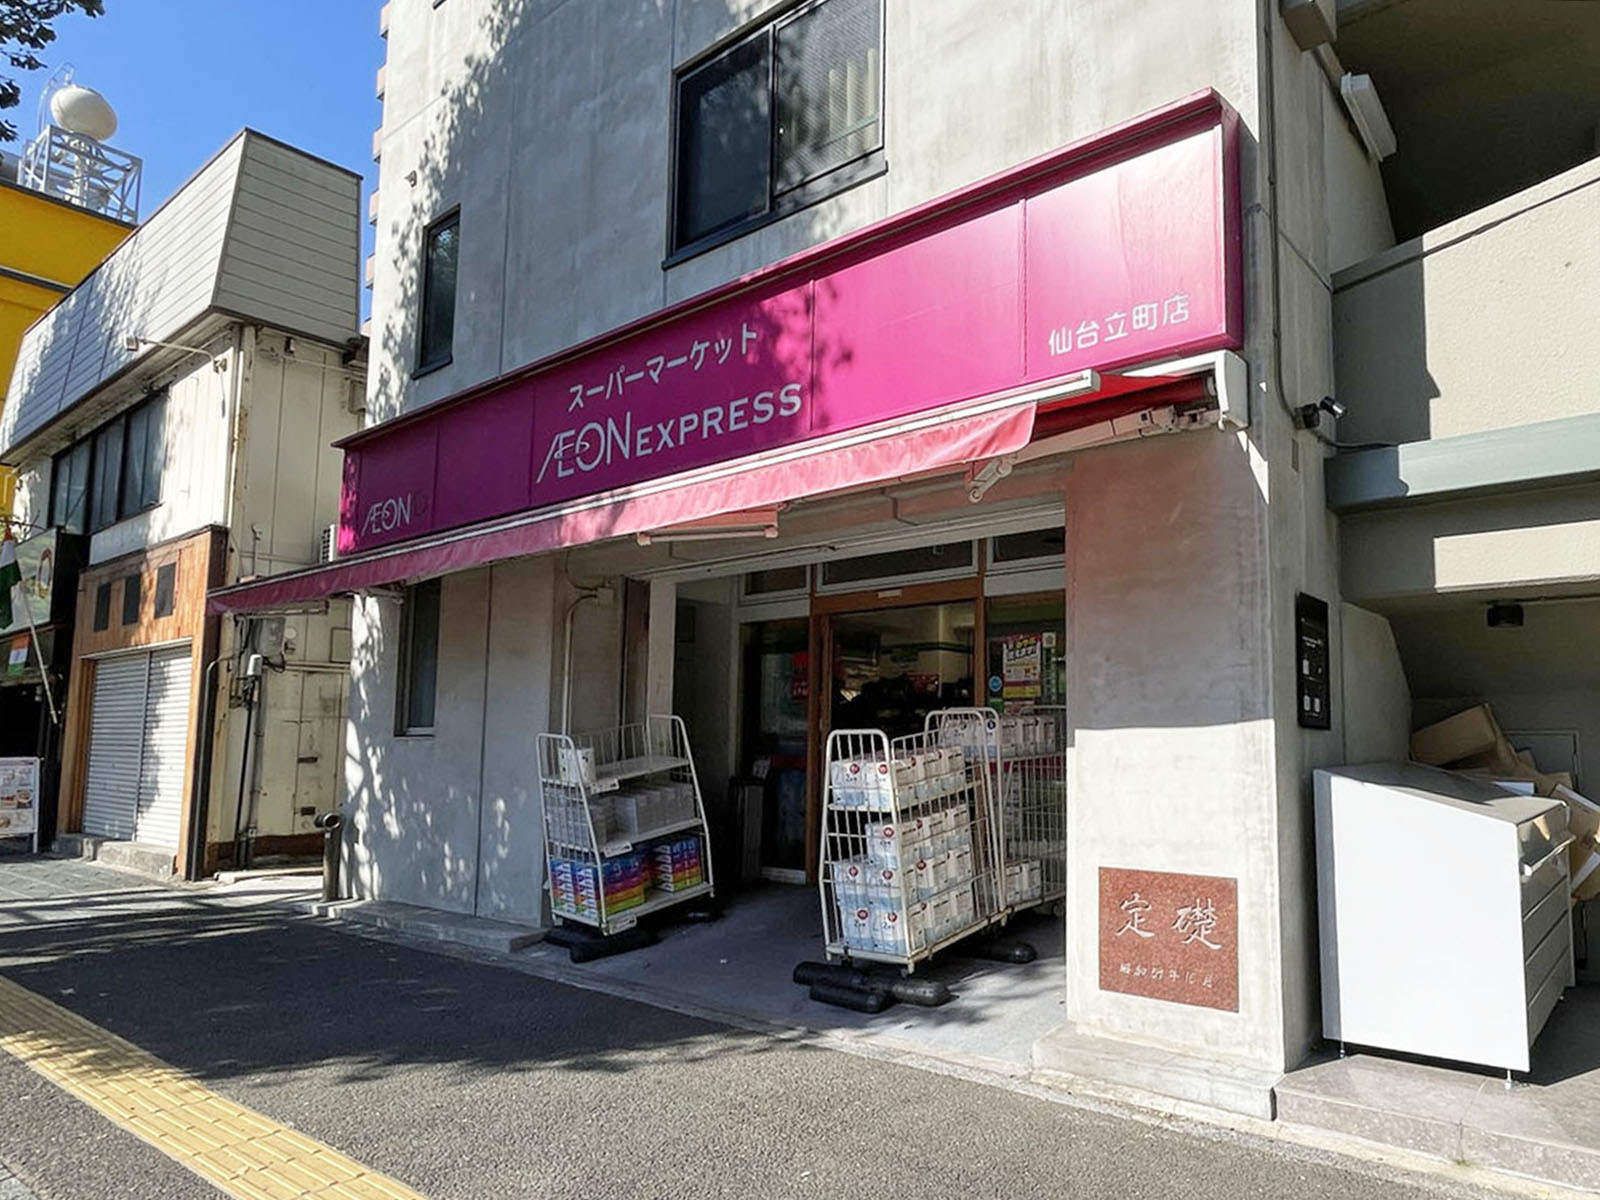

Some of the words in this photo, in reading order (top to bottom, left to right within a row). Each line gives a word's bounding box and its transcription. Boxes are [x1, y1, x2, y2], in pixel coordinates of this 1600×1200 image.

[1048, 294, 1190, 357] 仙台立町店
[568, 322, 757, 413] スーパーマーケット
[635, 383, 803, 457] EXPRESS
